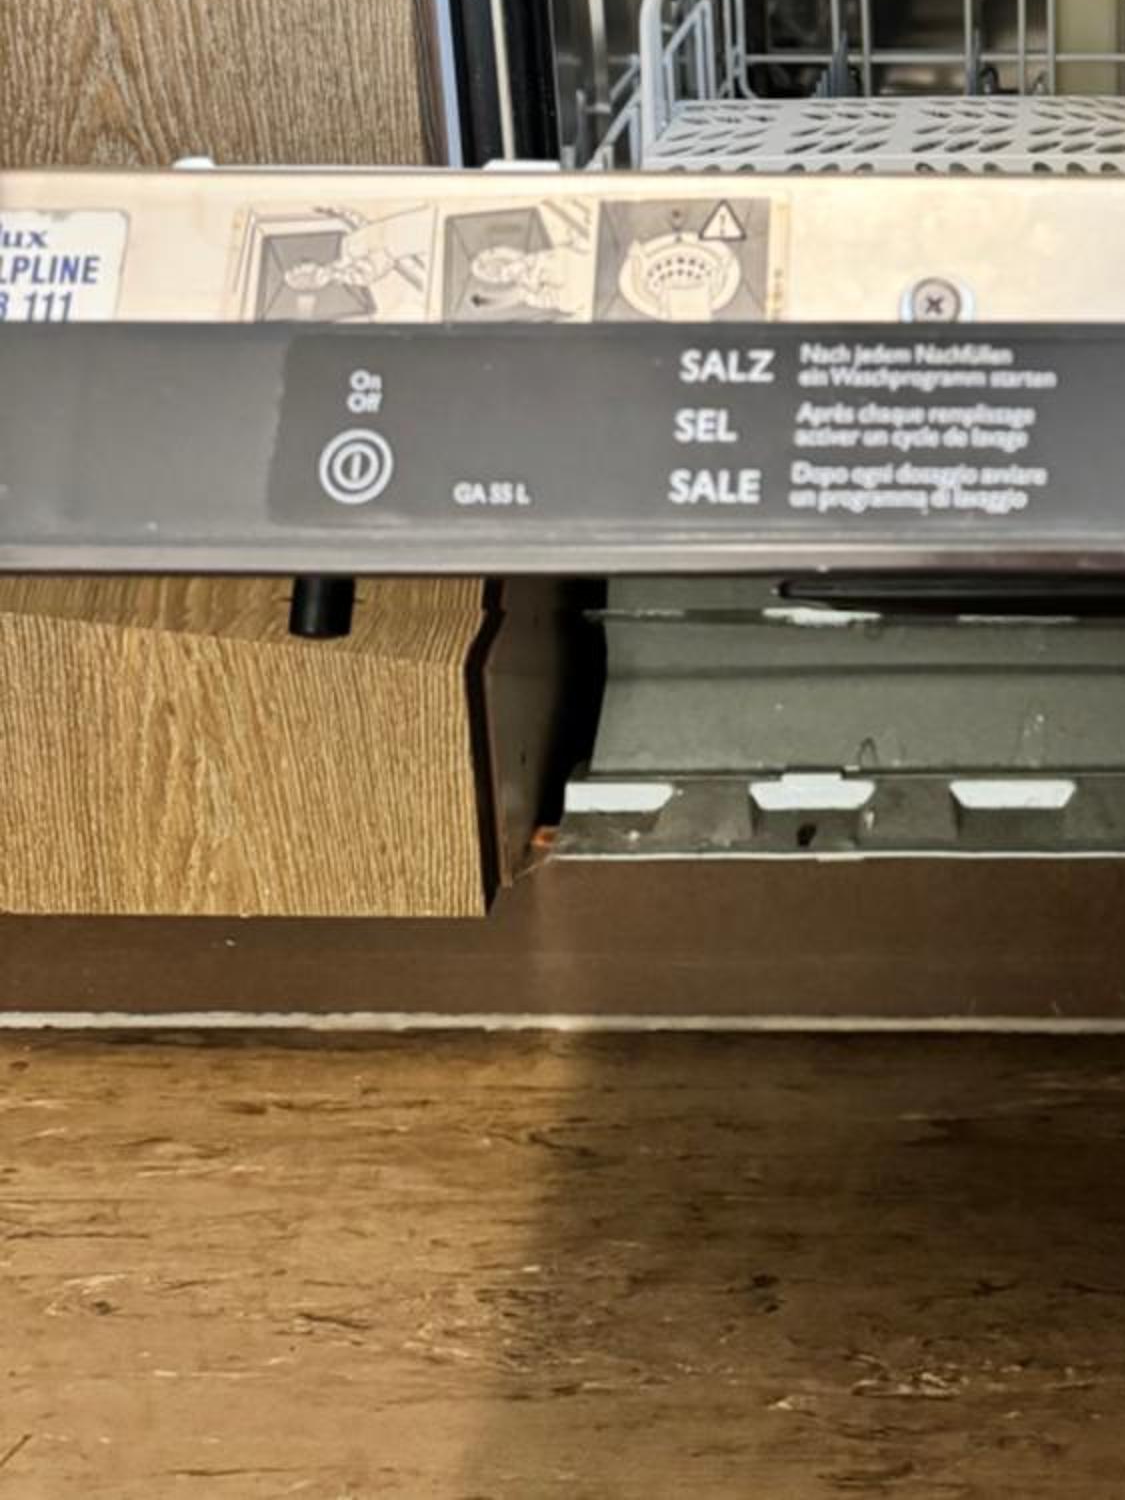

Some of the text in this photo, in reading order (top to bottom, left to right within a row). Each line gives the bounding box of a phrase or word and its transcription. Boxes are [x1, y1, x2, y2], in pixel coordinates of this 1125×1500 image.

[679, 348, 775, 383] SALZ
[799, 344, 1014, 367] Nach jedem Nachfüllen
[350, 370, 382, 391] On
[798, 367, 1058, 392] ein Waschprogramm starten
[347, 392, 382, 413] Off
[796, 401, 1036, 428] Après chaque remplissage
[674, 408, 738, 442] SEL
[795, 428, 1029, 452] activer un cycle de lavage
[669, 468, 761, 504] SALE
[791, 462, 849, 486] Dopo
[851, 463, 893, 488] ogni
[895, 463, 978, 488] dosaggio
[789, 490, 816, 507] un
[817, 489, 929, 513] programma
